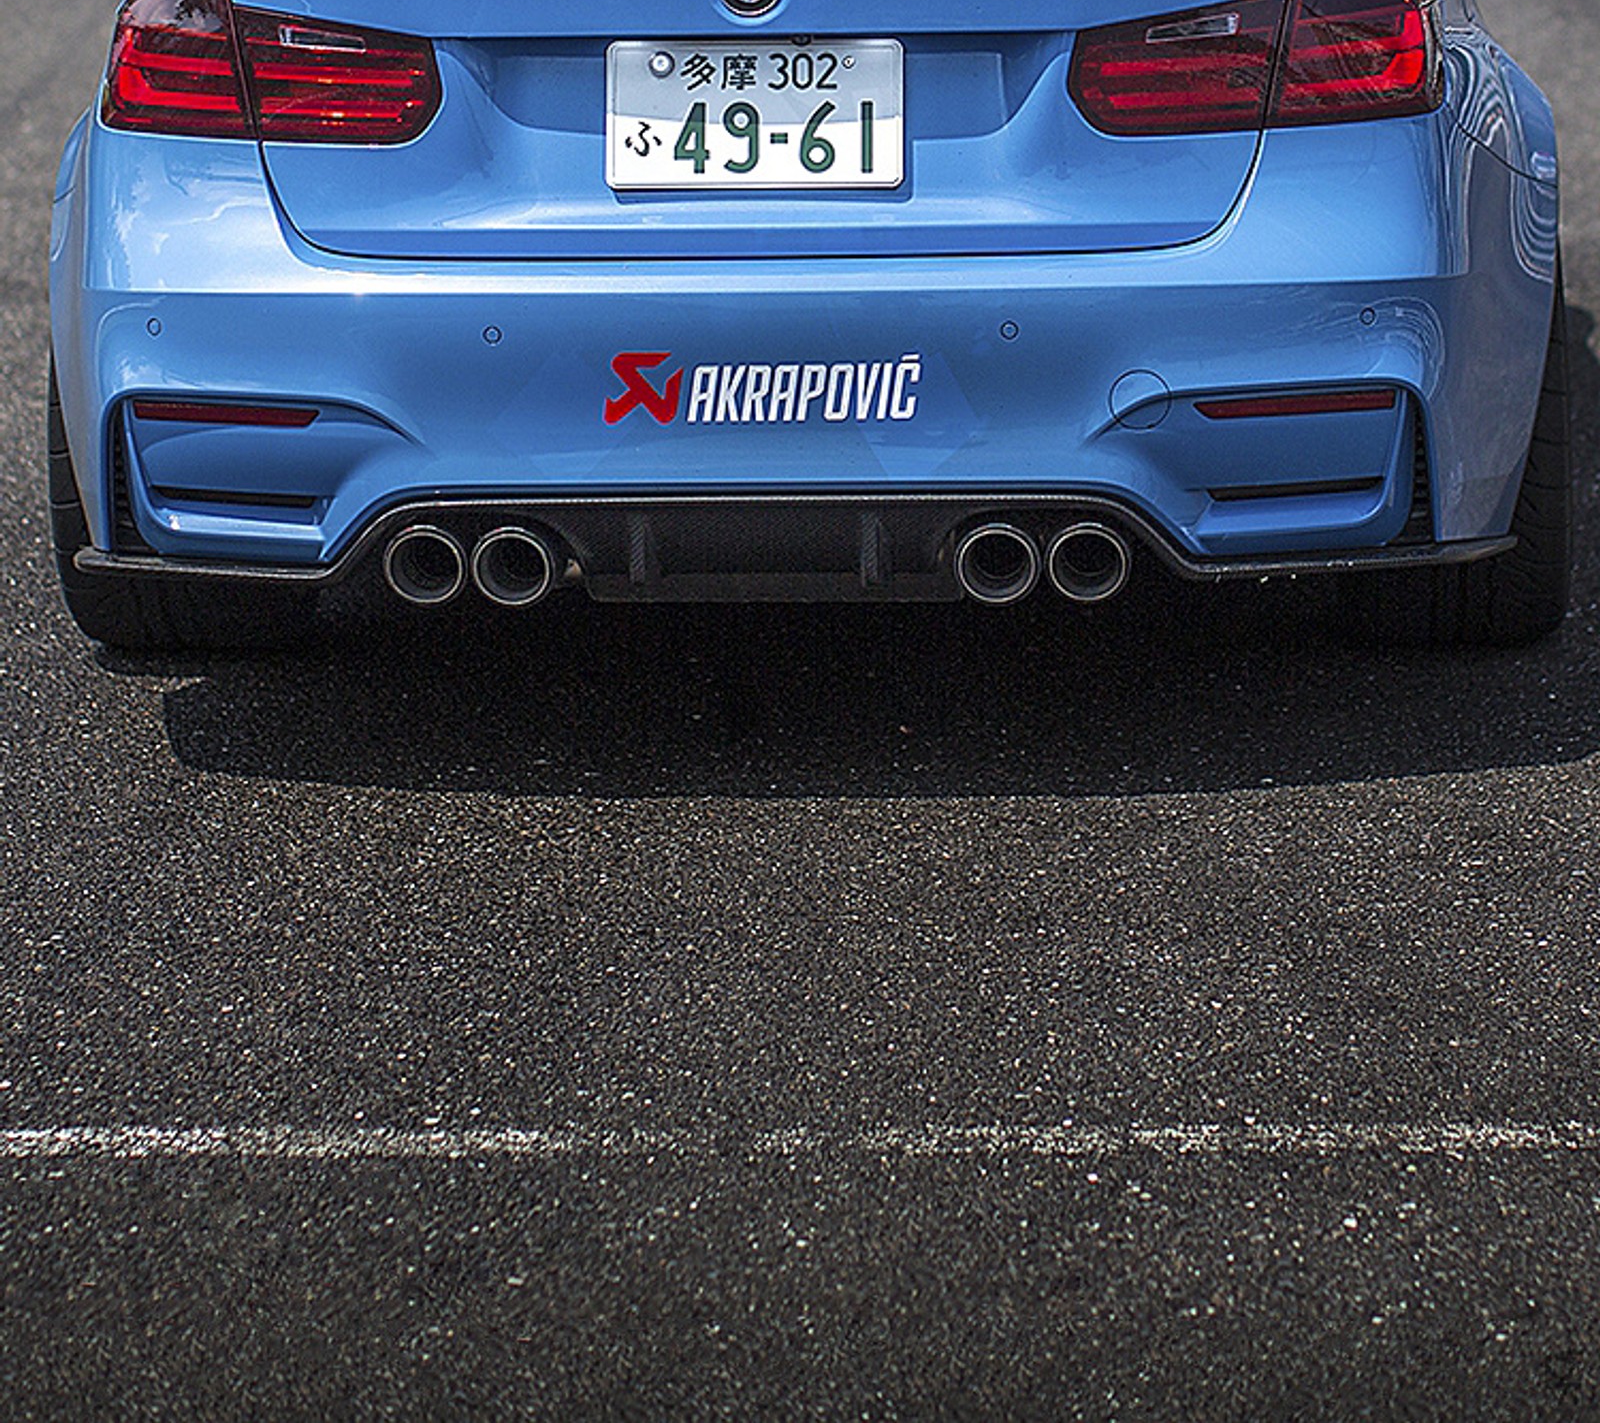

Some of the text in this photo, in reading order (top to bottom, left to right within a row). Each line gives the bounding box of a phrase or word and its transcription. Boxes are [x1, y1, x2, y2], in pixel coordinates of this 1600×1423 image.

[680, 53, 838, 90] 多摩 302
[625, 101, 873, 173] ふ 49-61
